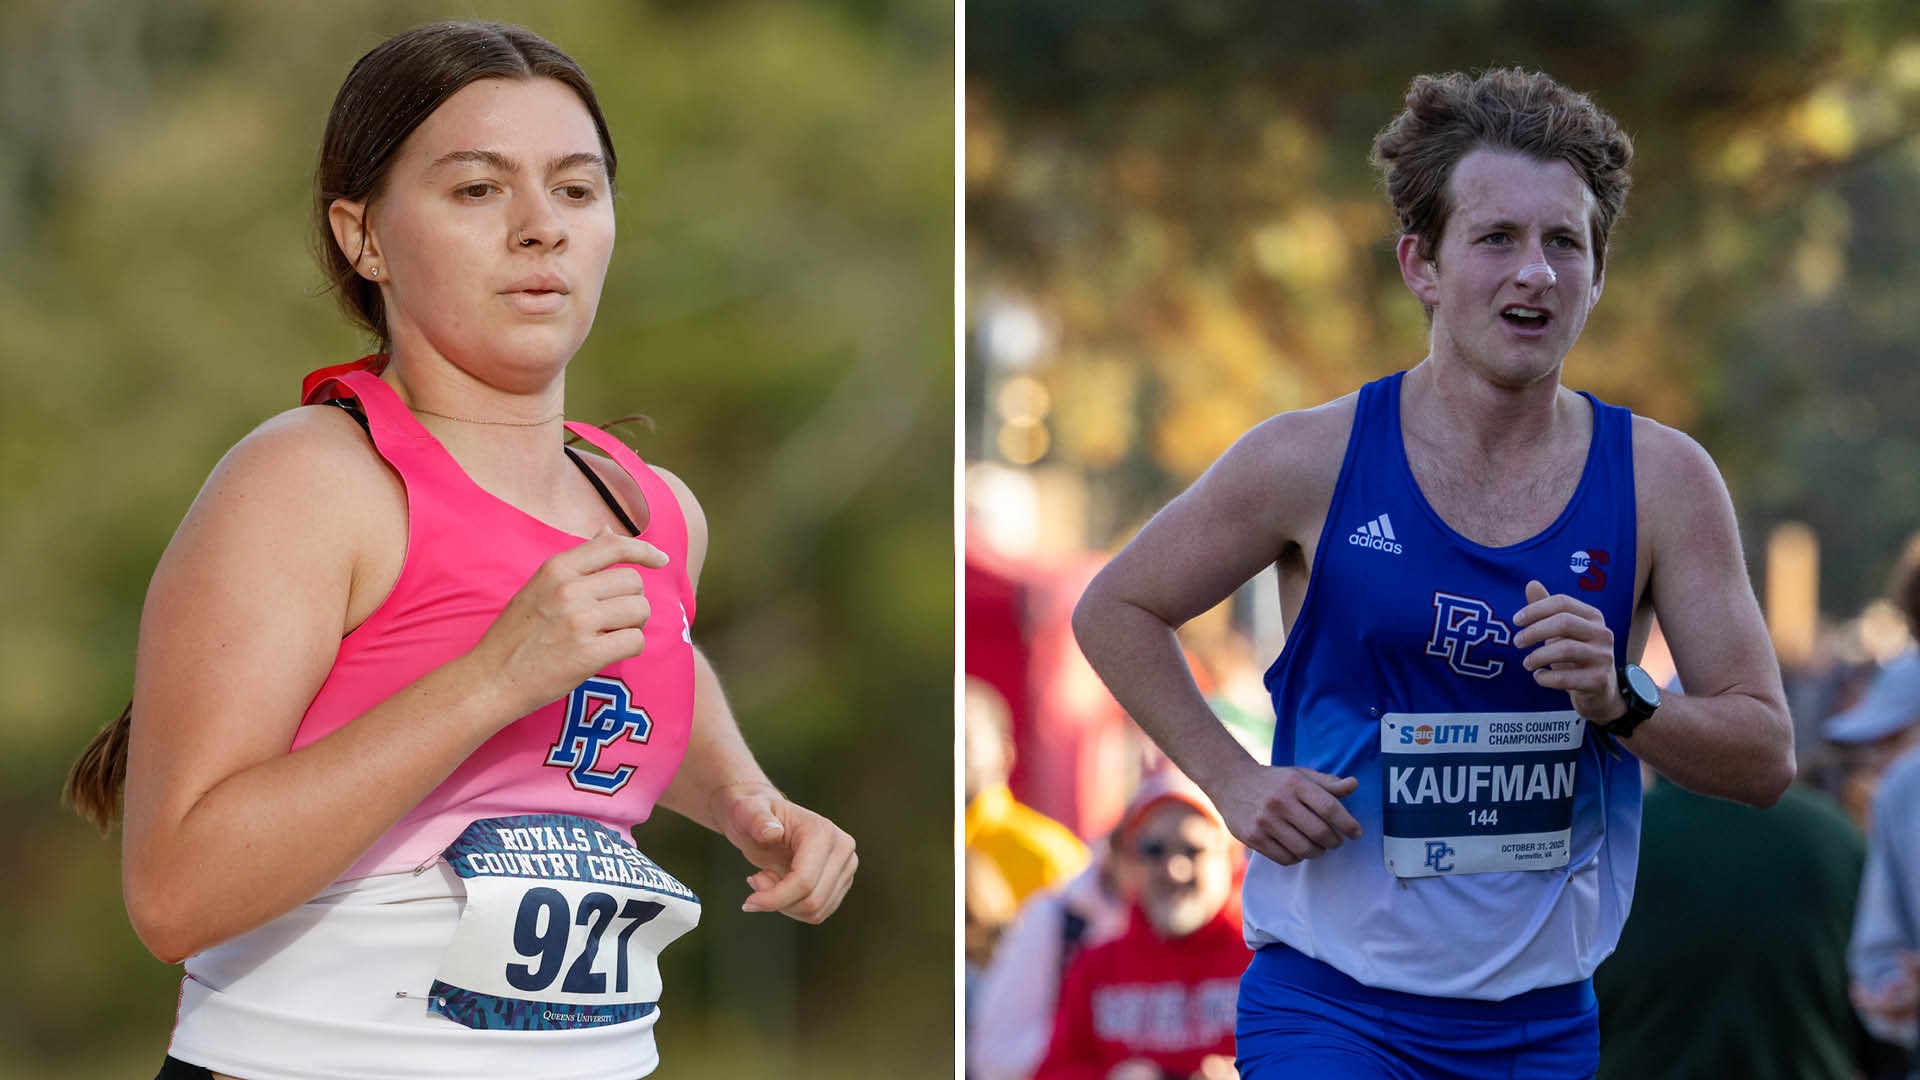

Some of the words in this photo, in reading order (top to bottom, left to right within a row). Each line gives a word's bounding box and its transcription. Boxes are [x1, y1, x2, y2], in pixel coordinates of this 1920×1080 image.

[1349, 534, 1402, 554] adidas
[1426, 591, 1511, 679] PC
[543, 674, 654, 796] PC
[1488, 732, 1570, 746] CHAMPIONSHIPS
[1489, 722, 1523, 734] CROSS
[1525, 720, 1570, 733] COUNTRY
[1389, 761, 1576, 805] KAUFMAN
[1468, 809, 1498, 826] 144
[496, 827, 591, 852] ROYALS
[594, 830, 653, 867] CSS
[1501, 843, 1535, 853] OCTOBER
[466, 852, 581, 878] COUNTRY
[505, 887, 666, 994] 927
